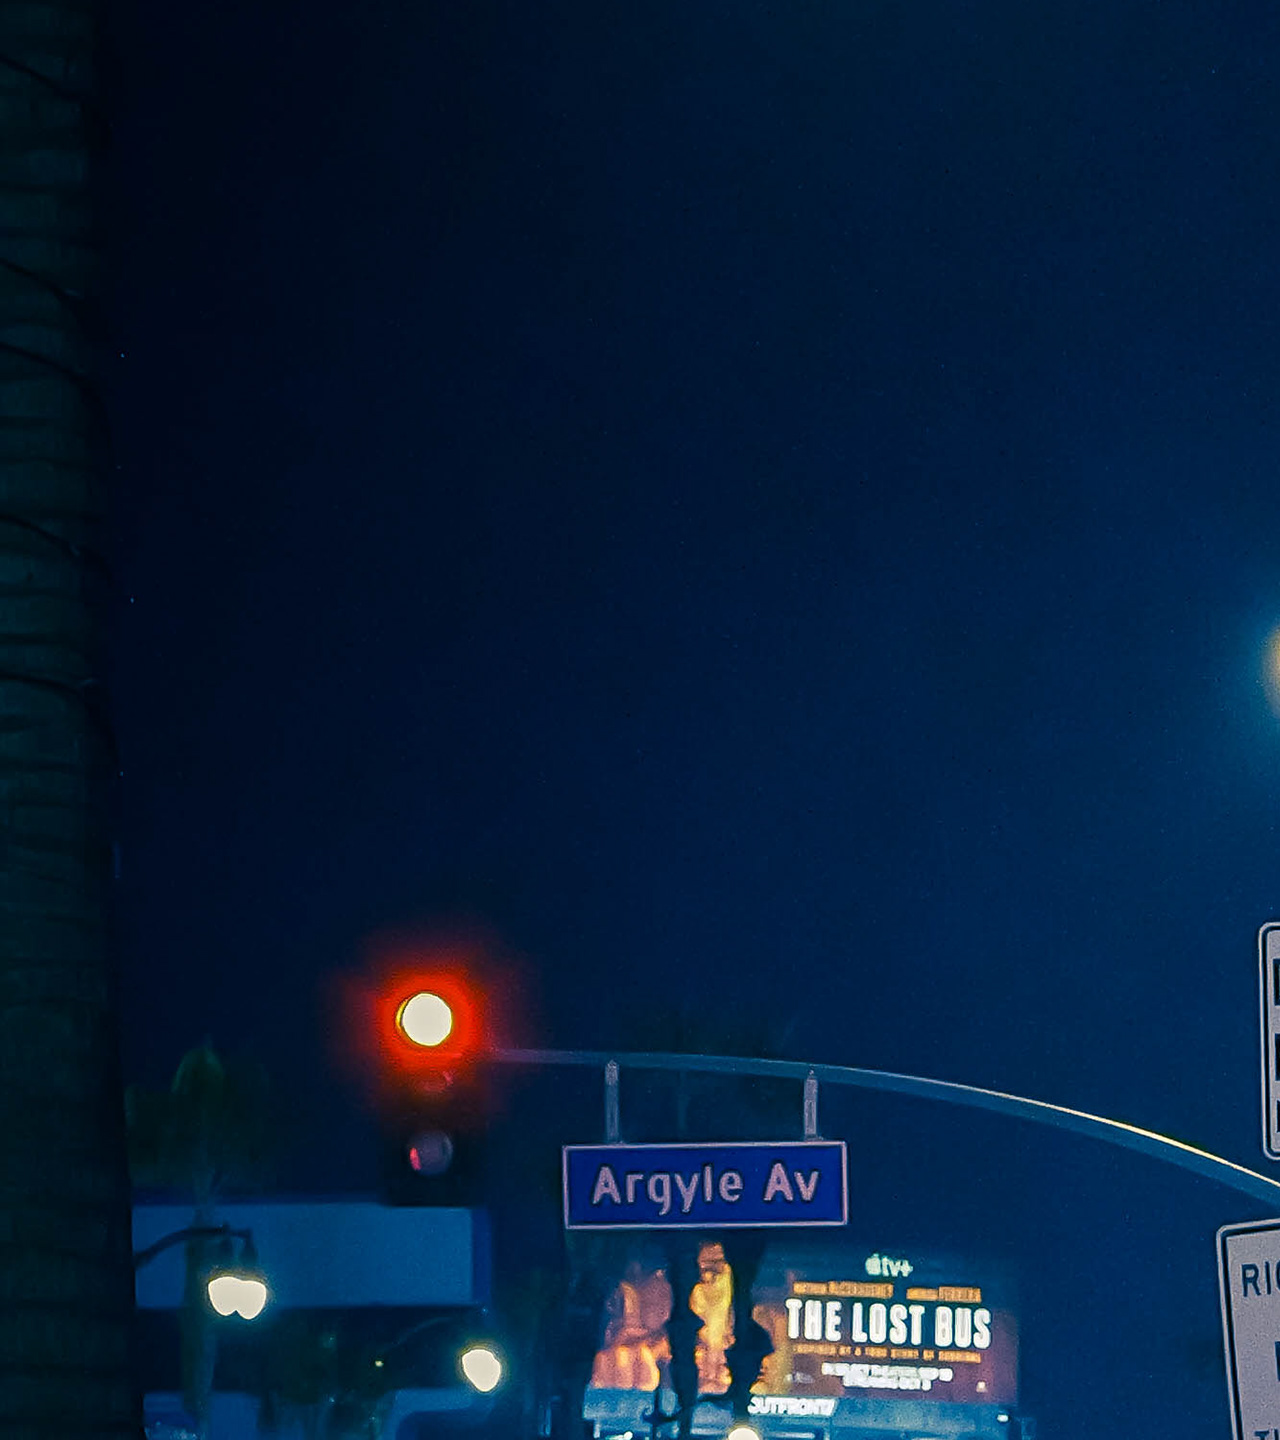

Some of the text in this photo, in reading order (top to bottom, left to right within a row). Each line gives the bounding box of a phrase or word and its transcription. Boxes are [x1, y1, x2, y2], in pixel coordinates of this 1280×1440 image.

[592, 1163, 820, 1215] Argyle Av
[785, 1298, 991, 1349] THE LOST BUS
